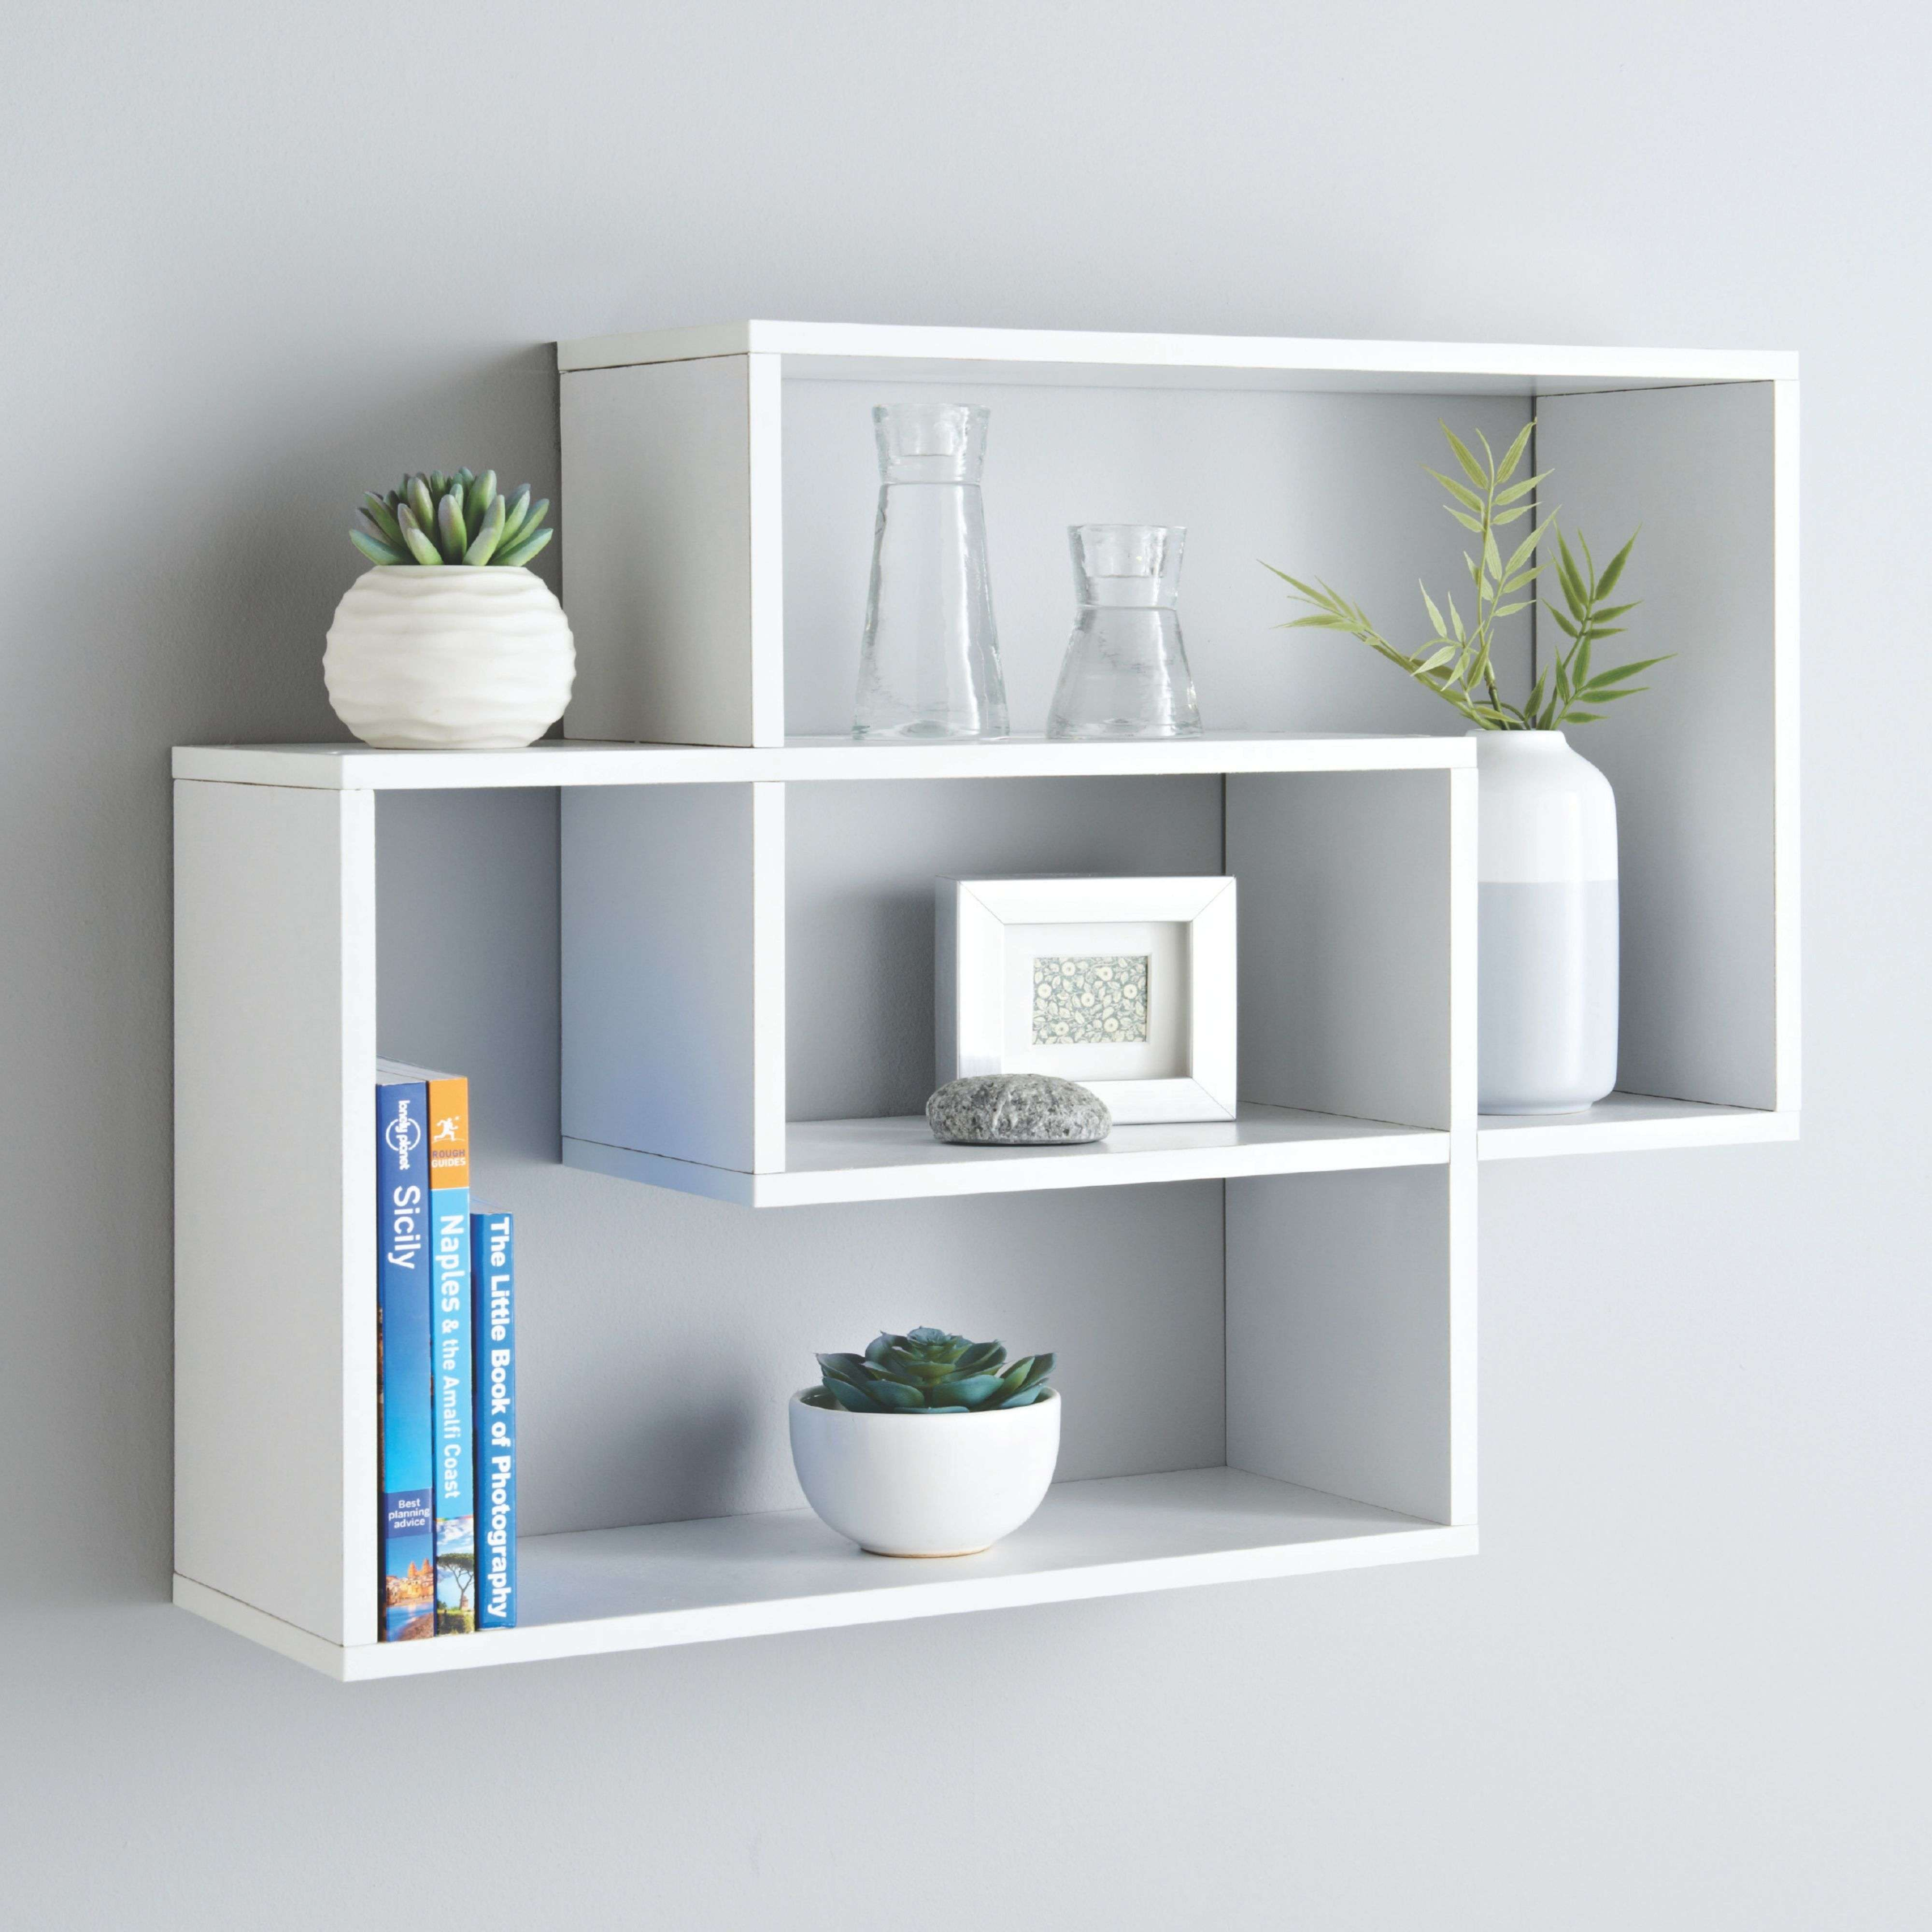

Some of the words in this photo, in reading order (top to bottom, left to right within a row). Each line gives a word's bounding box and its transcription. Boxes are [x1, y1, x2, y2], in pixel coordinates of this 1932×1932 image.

[395, 1100, 411, 1133] lonely
[396, 1135, 411, 1170] planet
[431, 1157, 466, 1168] GUIDES
[432, 1149, 465, 1158] ROUGH
[388, 1185, 421, 1269] Sicily
[490, 1216, 510, 1267] The
[435, 1214, 465, 1313] Naples
[491, 1274, 510, 1342] Little
[441, 1319, 460, 1334] &
[442, 1338, 460, 1371] the
[491, 1349, 511, 1416] Book
[442, 1375, 461, 1439] Amalfi
[491, 1421, 511, 1448] of
[443, 1443, 462, 1499] Coast
[388, 1508, 430, 1521] planning
[398, 1498, 421, 1508] Best
[394, 1518, 425, 1529] advice
[487, 1455, 512, 1618] Photography
